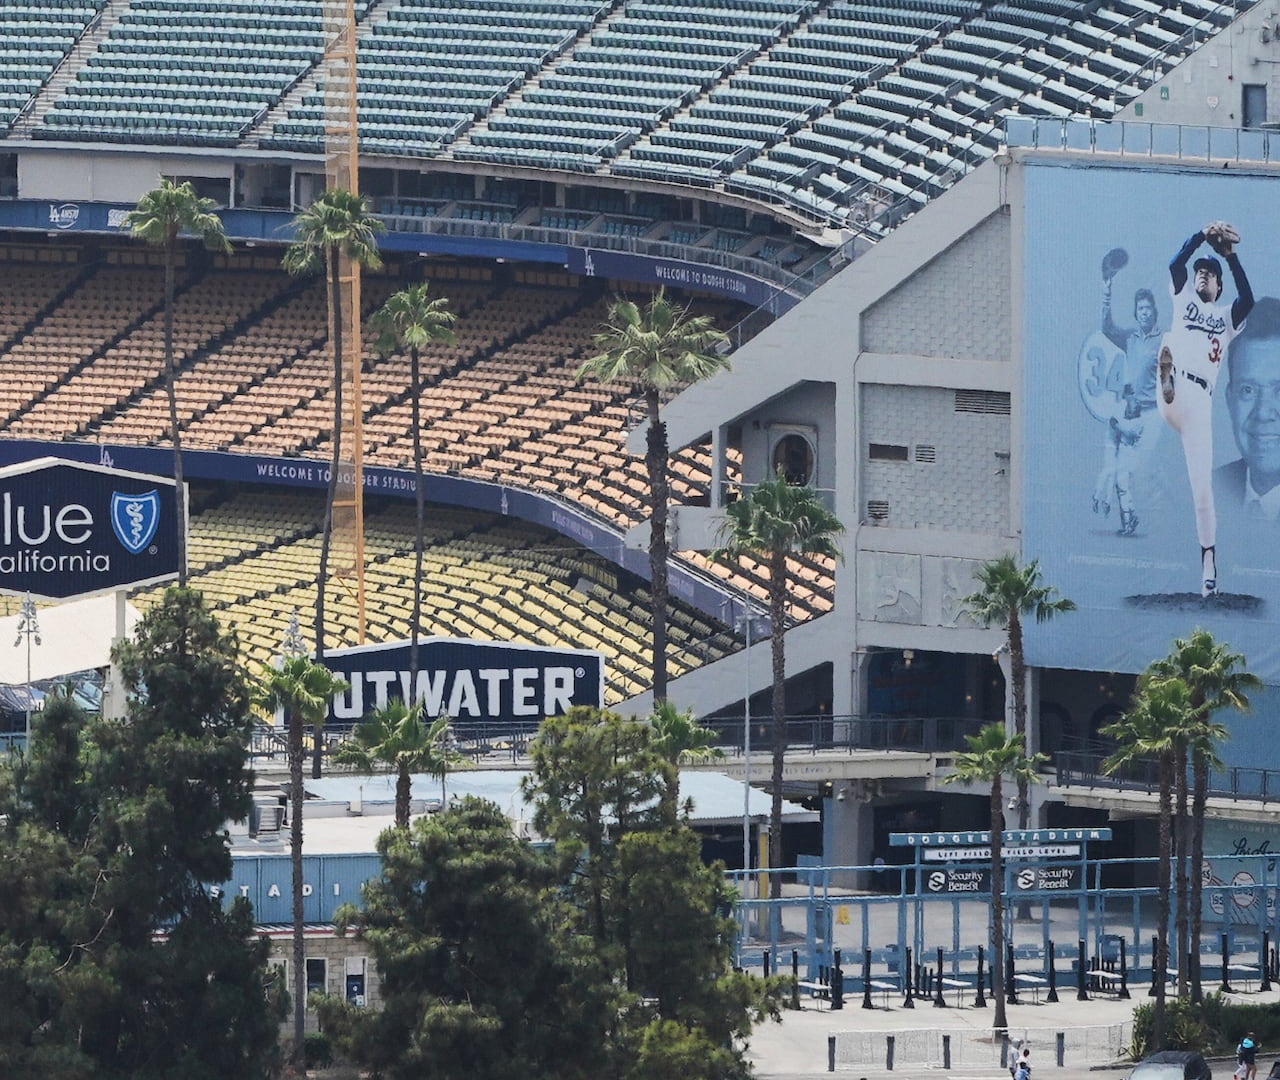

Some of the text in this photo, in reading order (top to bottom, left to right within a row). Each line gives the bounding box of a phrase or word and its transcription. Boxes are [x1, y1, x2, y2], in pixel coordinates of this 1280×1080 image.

[655, 265, 690, 283] WELCOME
[691, 271, 700, 284] TO
[1208, 337, 1223, 367] 3
[1085, 346, 1126, 401] 34
[257, 463, 313, 481] WELCOME
[317, 469, 332, 483] TO
[382, 475, 417, 492] STADIU
[324, 667, 576, 719] UTWATER
[907, 830, 1100, 845] DODGER STADIUM
[947, 870, 983, 882] Security
[1038, 867, 1075, 880] Security
[210, 883, 366, 899] STADI
[947, 881, 980, 891] Benefit
[1038, 878, 1070, 889] Benefit
